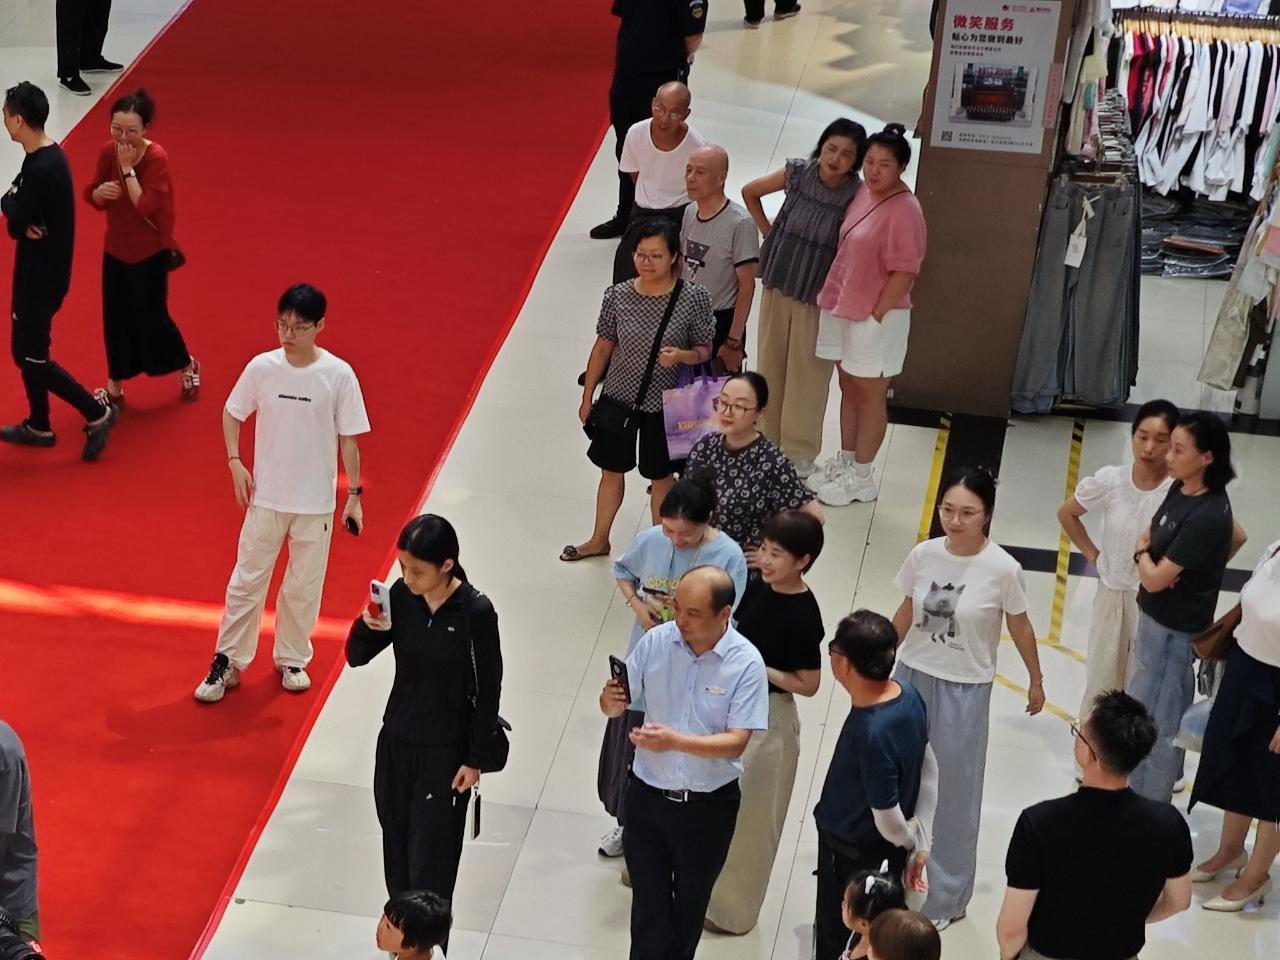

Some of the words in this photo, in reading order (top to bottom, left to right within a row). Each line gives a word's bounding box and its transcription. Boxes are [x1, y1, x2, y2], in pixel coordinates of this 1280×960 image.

[953, 14, 1015, 31] 微笑服务
[951, 32, 1023, 45] 贴心为您做到最好
